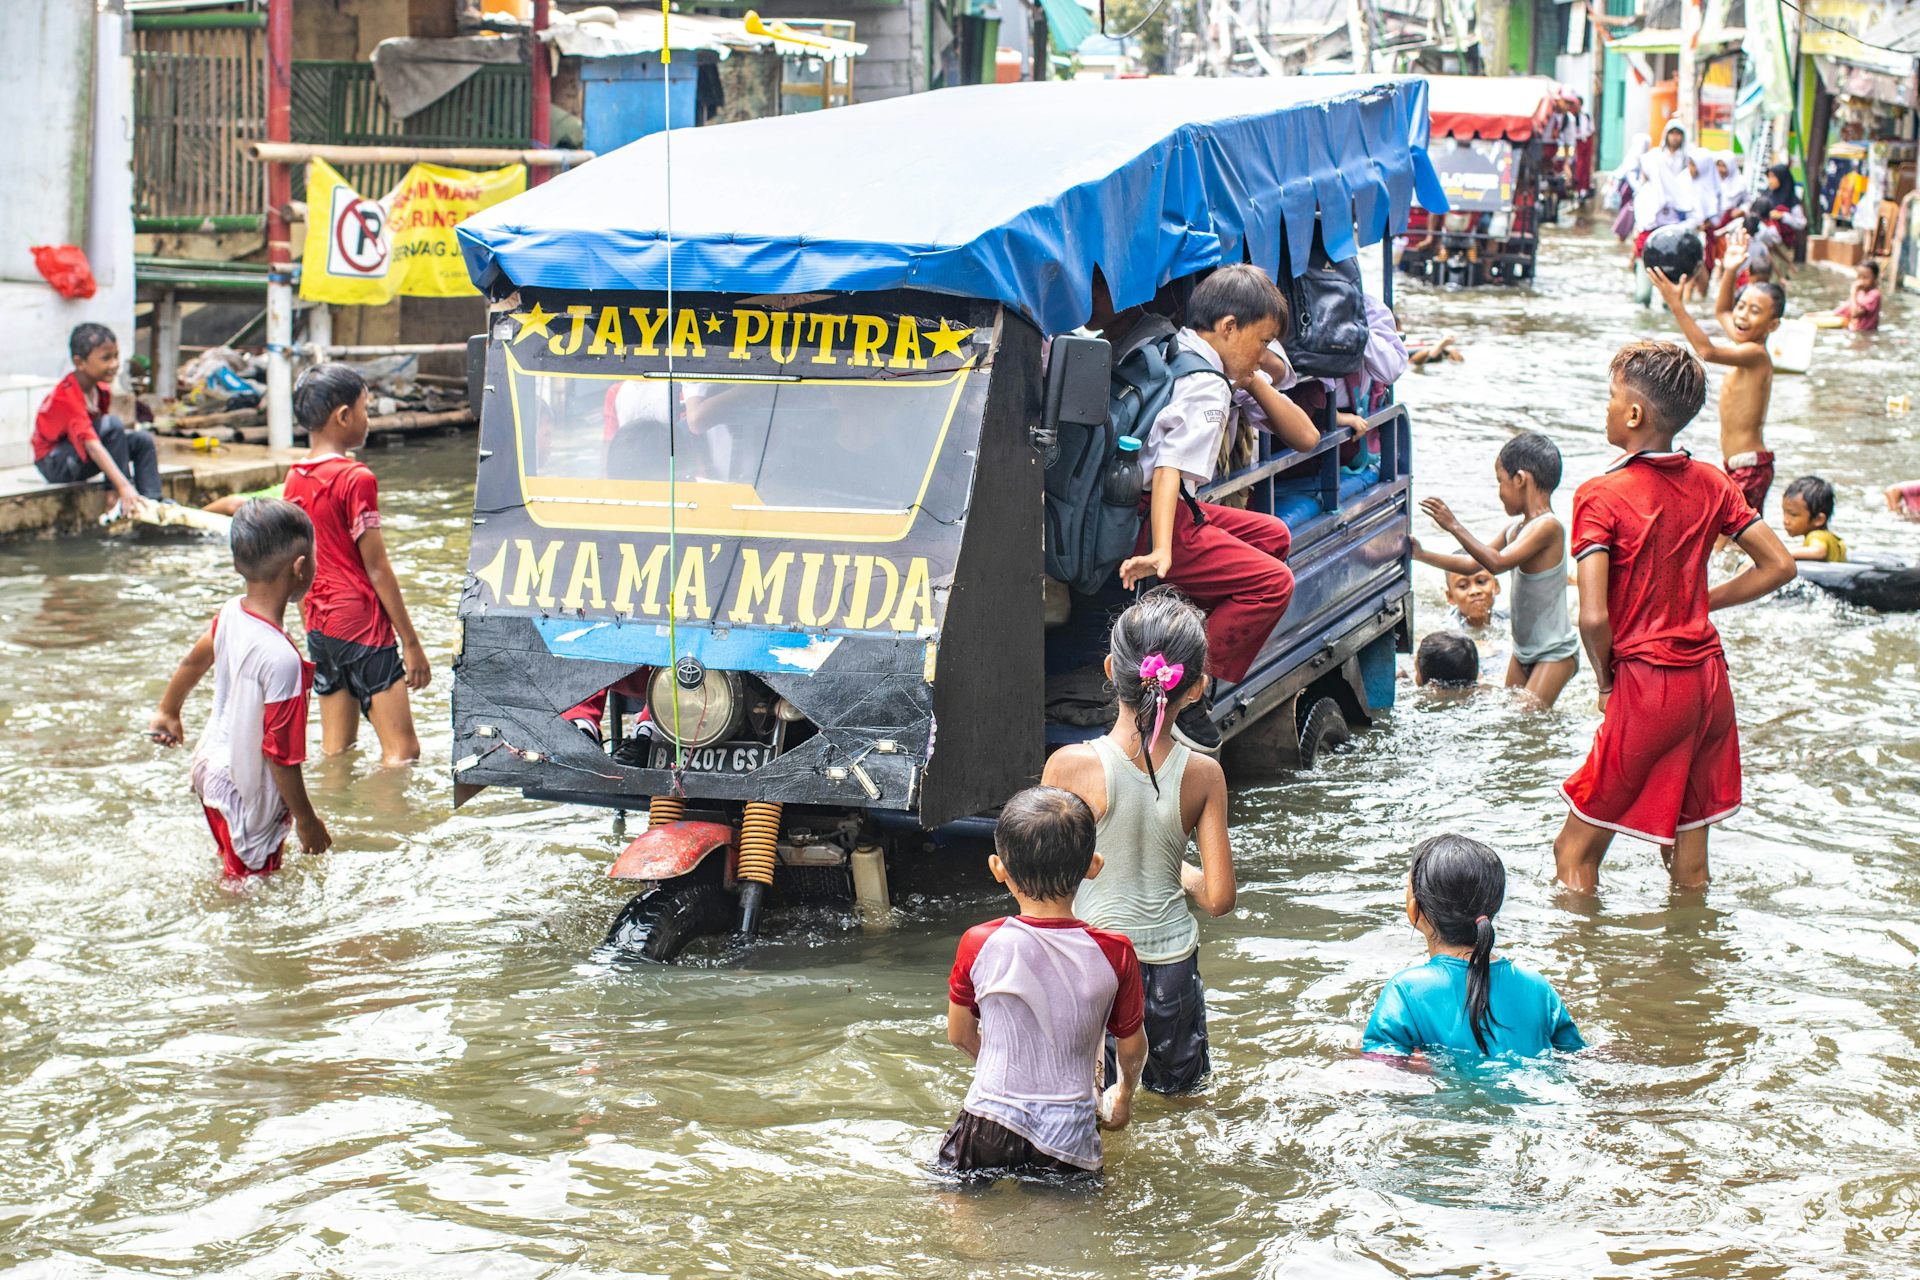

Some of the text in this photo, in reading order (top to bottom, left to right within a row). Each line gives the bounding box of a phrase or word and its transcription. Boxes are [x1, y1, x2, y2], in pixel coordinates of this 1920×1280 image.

[548, 305, 929, 370] JAYA PUTRA
[728, 548, 938, 632] MUDA
